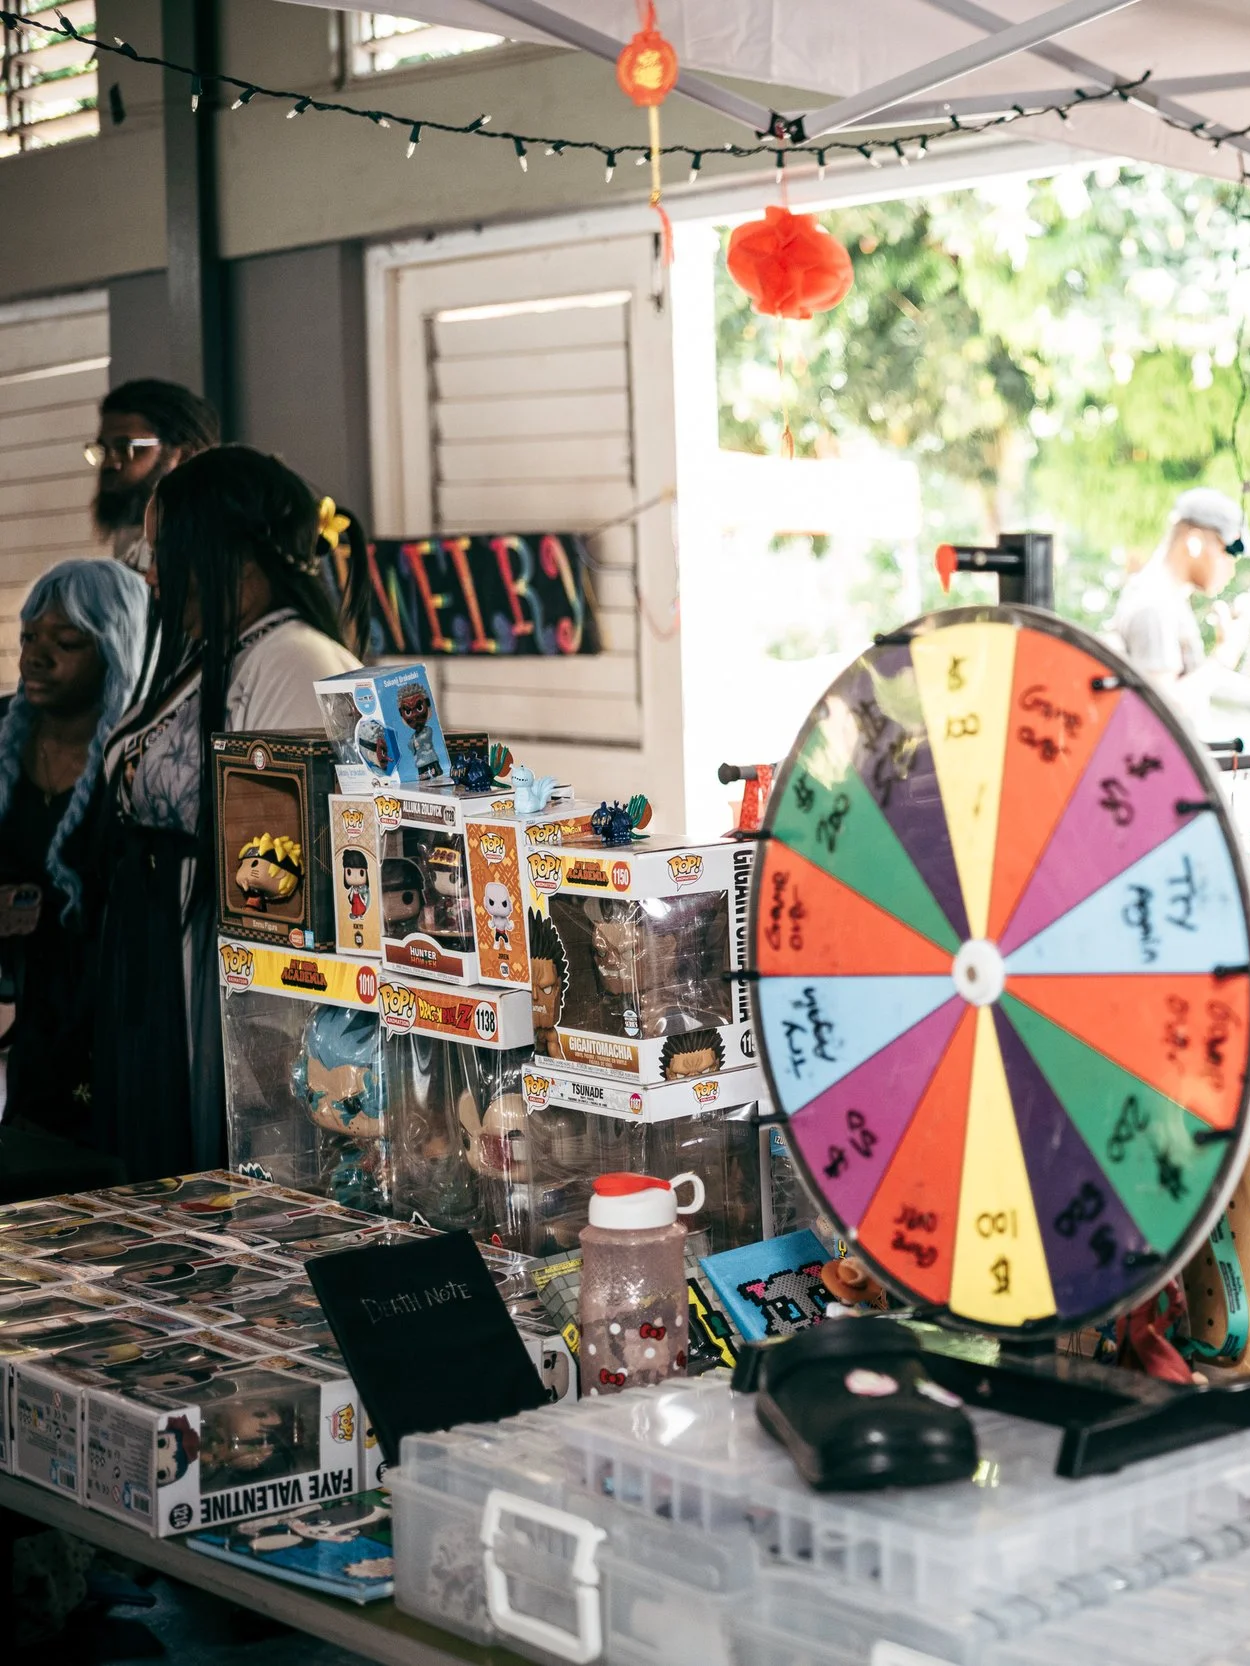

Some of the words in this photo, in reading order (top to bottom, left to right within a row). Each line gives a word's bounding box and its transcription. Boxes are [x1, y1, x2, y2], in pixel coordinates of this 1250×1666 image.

[374, 795, 400, 818] POP!
[402, 801, 420, 814] ALLUKA
[341, 809, 364, 829] POP!
[480, 833, 504, 854] POP!
[525, 824, 561, 846] POP!
[526, 854, 562, 881] POP!
[566, 868, 609, 887] ACADEMIA
[612, 867, 629, 886] 1150
[667, 855, 703, 878] POP!
[220, 945, 253, 975] POP!
[410, 946, 437, 960] HUNTER
[281, 967, 328, 991] ACADEMIA
[359, 973, 375, 997] 1010
[378, 982, 416, 1018] POP!
[476, 1009, 495, 1033] 1138
[569, 1037, 633, 1060] GIGANTOMACHIA
[523, 1074, 550, 1097] POP!
[572, 1083, 604, 1099] TSUNADE
[693, 1081, 718, 1097] POP!
[361, 1293, 422, 1324] DEATH
[338, 1403, 355, 1442] POP!
[309, 1468, 353, 1500] FAYE
[201, 1474, 302, 1524] VALENTINE
